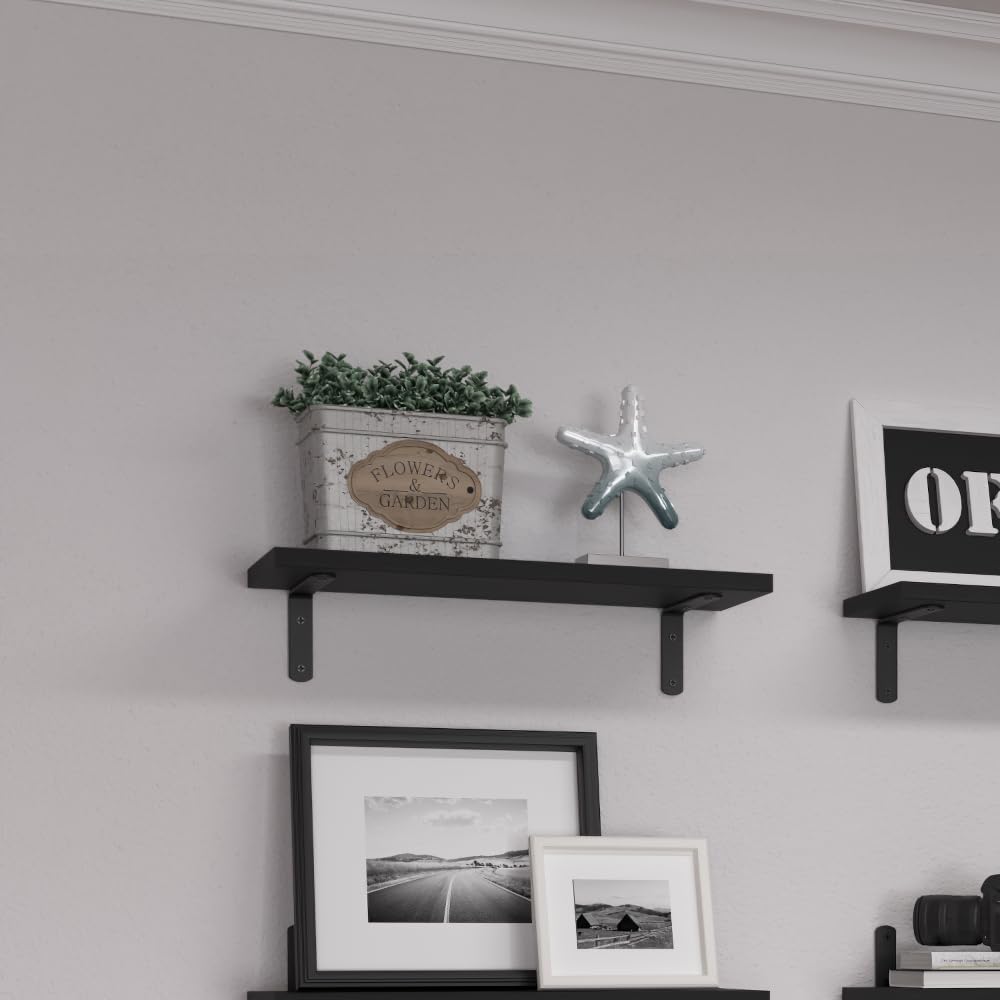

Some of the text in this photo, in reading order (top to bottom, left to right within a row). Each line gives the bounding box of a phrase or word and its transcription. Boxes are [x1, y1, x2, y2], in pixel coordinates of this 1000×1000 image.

[370, 460, 460, 490] FLOWERS
[409, 478, 423, 493] &
[379, 493, 451, 512] GARDEN
